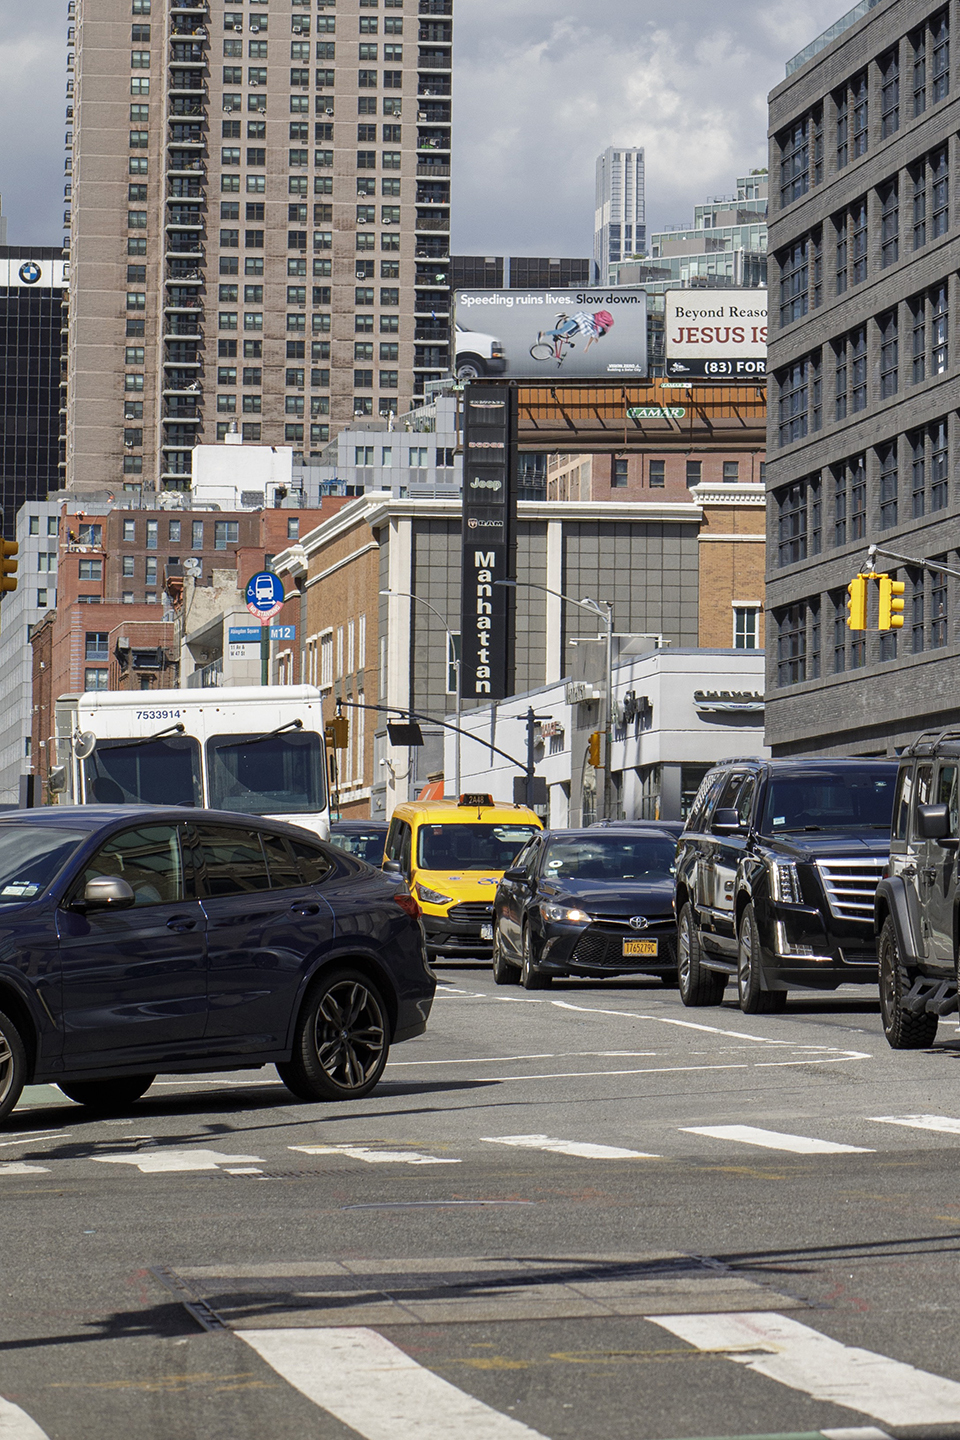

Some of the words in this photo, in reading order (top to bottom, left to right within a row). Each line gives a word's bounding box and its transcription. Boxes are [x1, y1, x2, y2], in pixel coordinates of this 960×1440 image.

[460, 294, 514, 307] Speeding
[515, 294, 544, 305] ruins
[545, 294, 574, 305] lives.
[576, 294, 604, 304] Slow
[605, 294, 641, 304] down.
[675, 306, 724, 321] Beyond
[729, 306, 768, 318] Reaso
[672, 327, 745, 344] JESUS
[704, 361, 732, 374] (83)
[736, 361, 766, 373] FOR
[470, 477, 502, 491] Jeep
[249, 605, 256, 613] NO
[474, 551, 496, 693] Manhattan
[270, 627, 291, 638] M12
[136, 710, 181, 719] 7533914
